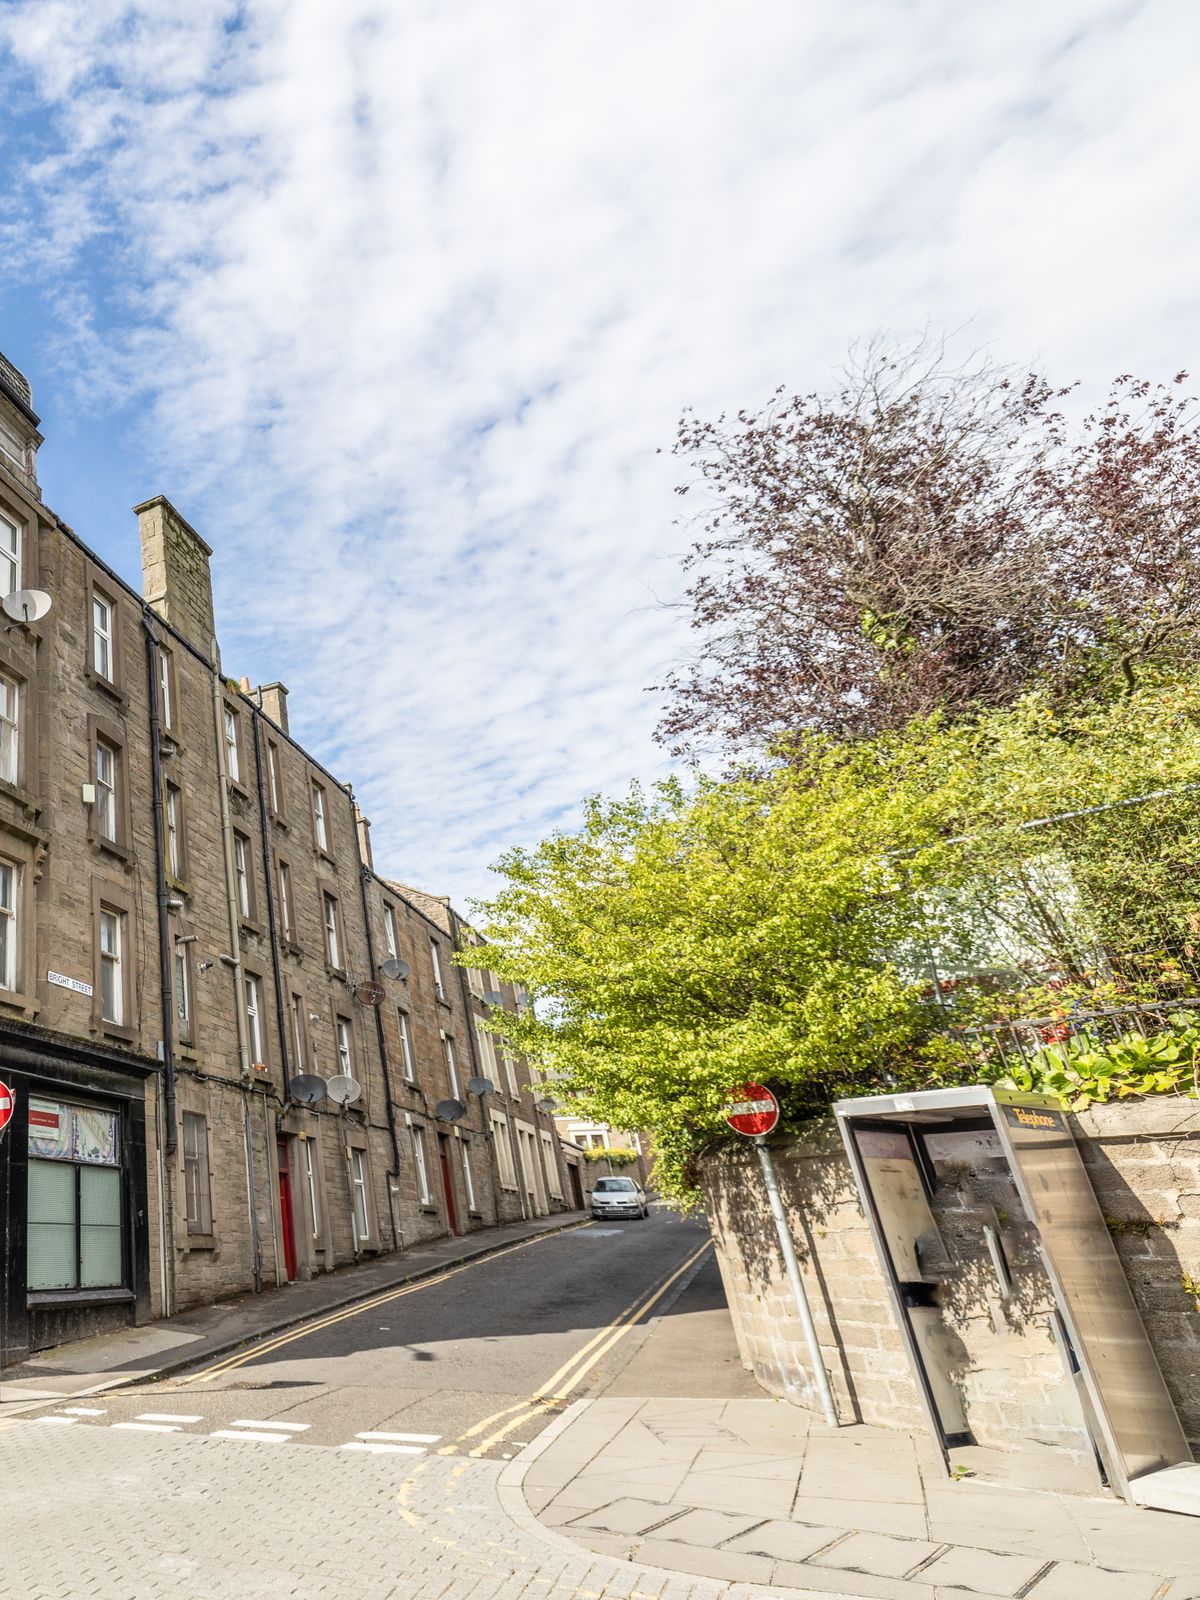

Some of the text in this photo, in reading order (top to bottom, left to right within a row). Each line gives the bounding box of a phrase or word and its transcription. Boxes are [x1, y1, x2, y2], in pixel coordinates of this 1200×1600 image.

[49, 973, 91, 994] BRIGHT STREET
[1012, 1107, 1056, 1129] Telephone
